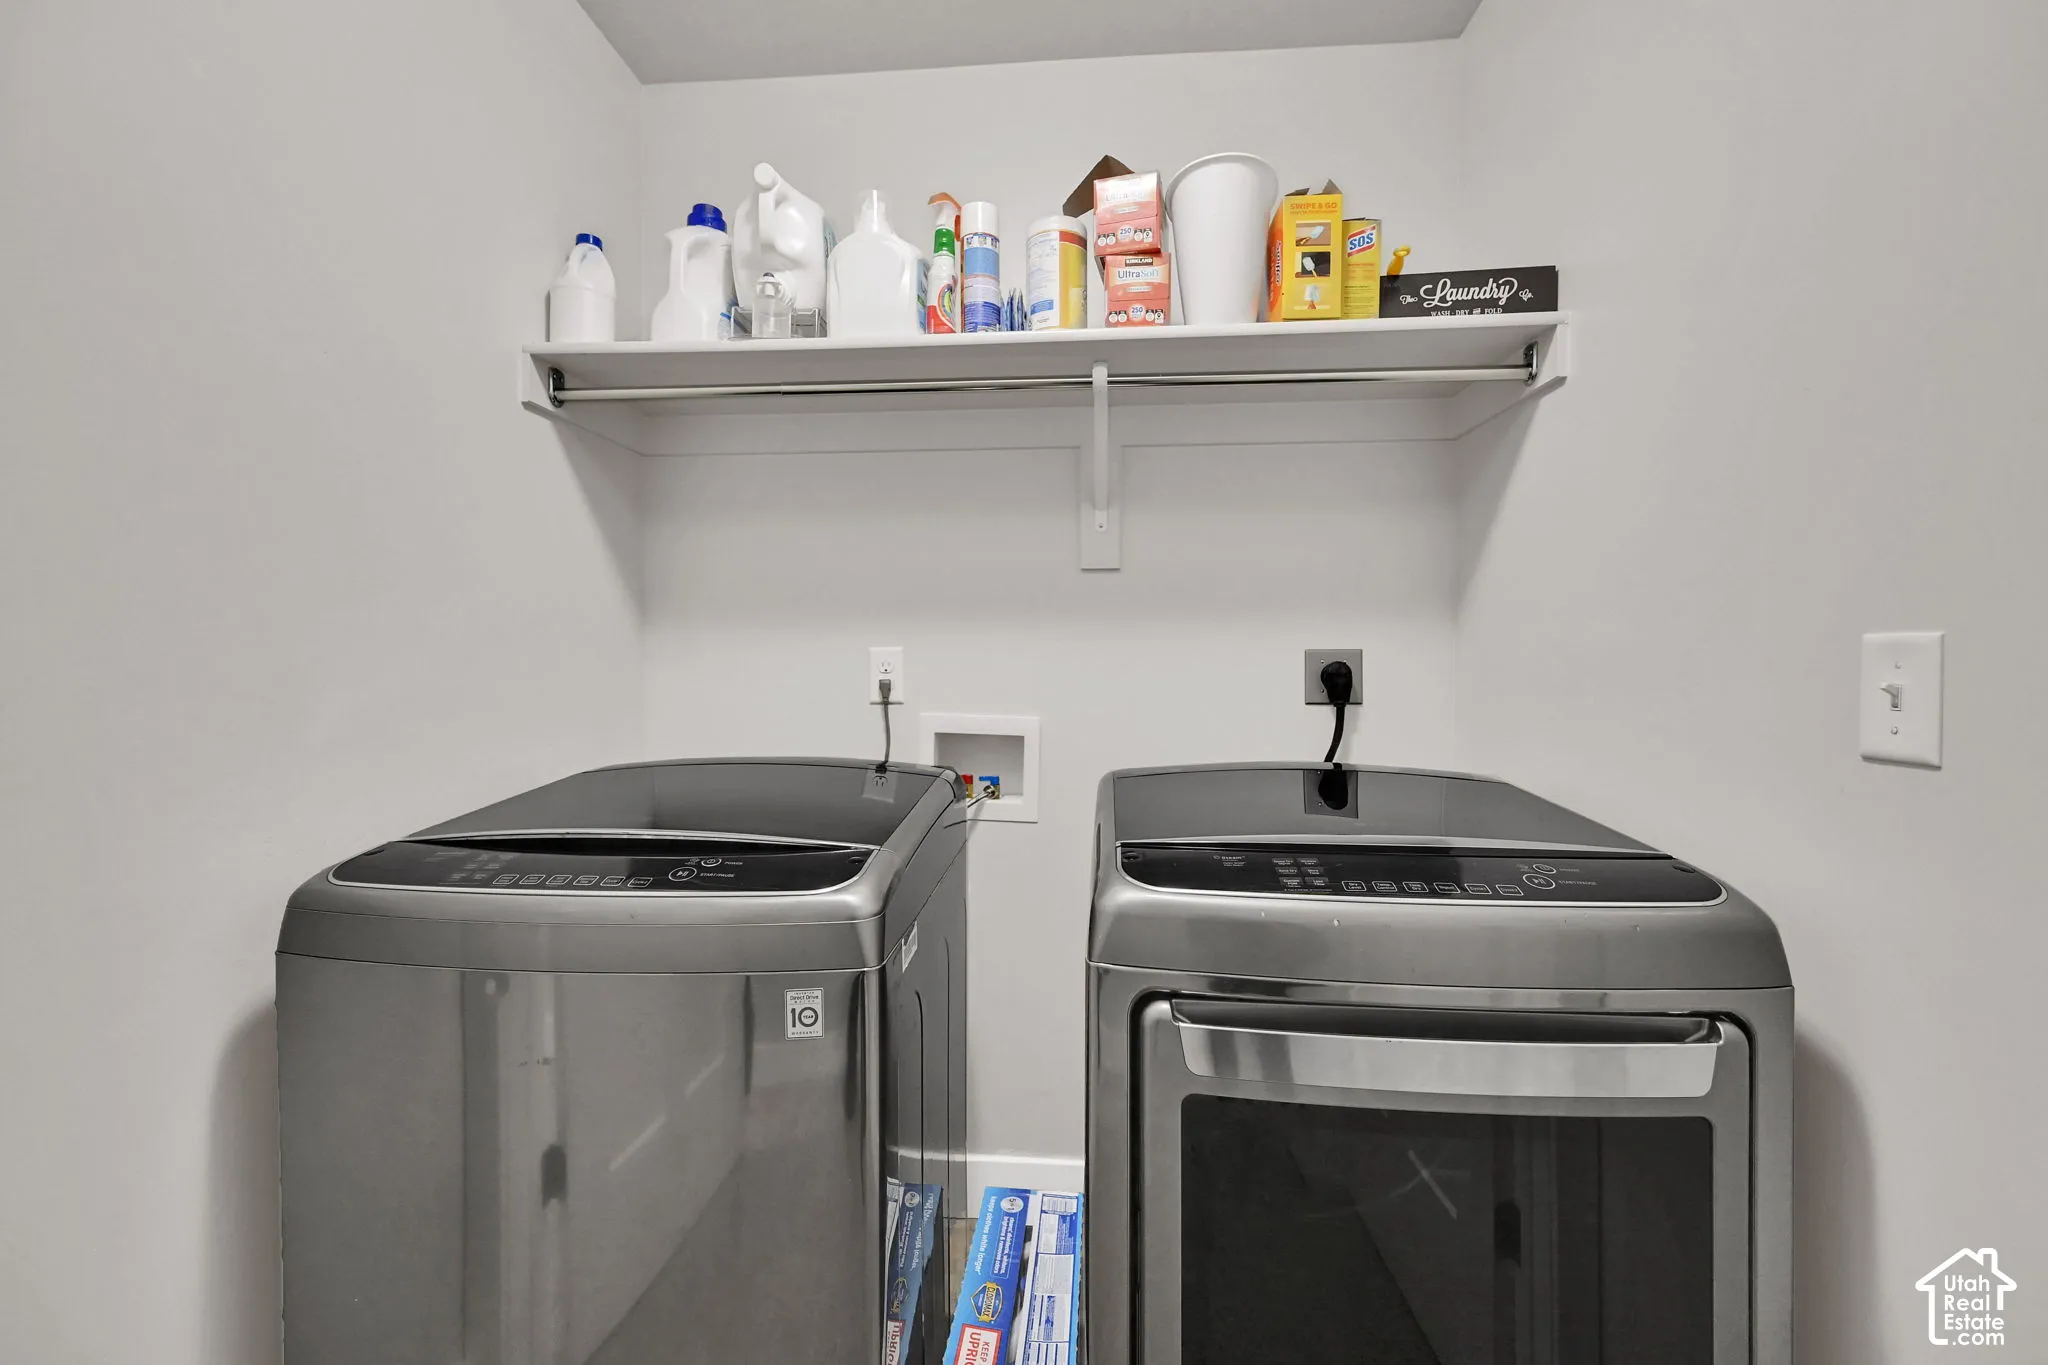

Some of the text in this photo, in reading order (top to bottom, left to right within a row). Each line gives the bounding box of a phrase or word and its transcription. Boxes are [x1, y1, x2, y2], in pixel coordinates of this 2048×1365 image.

[1349, 232, 1374, 250] SOS
[1400, 295, 1418, 304] The
[1420, 277, 1518, 307] Laundry
[790, 1007, 819, 1028] 10
[984, 1212, 993, 1233] clothes
[979, 1234, 988, 1252] white
[993, 1260, 1001, 1274] odors
[981, 1341, 992, 1363] KEEP
